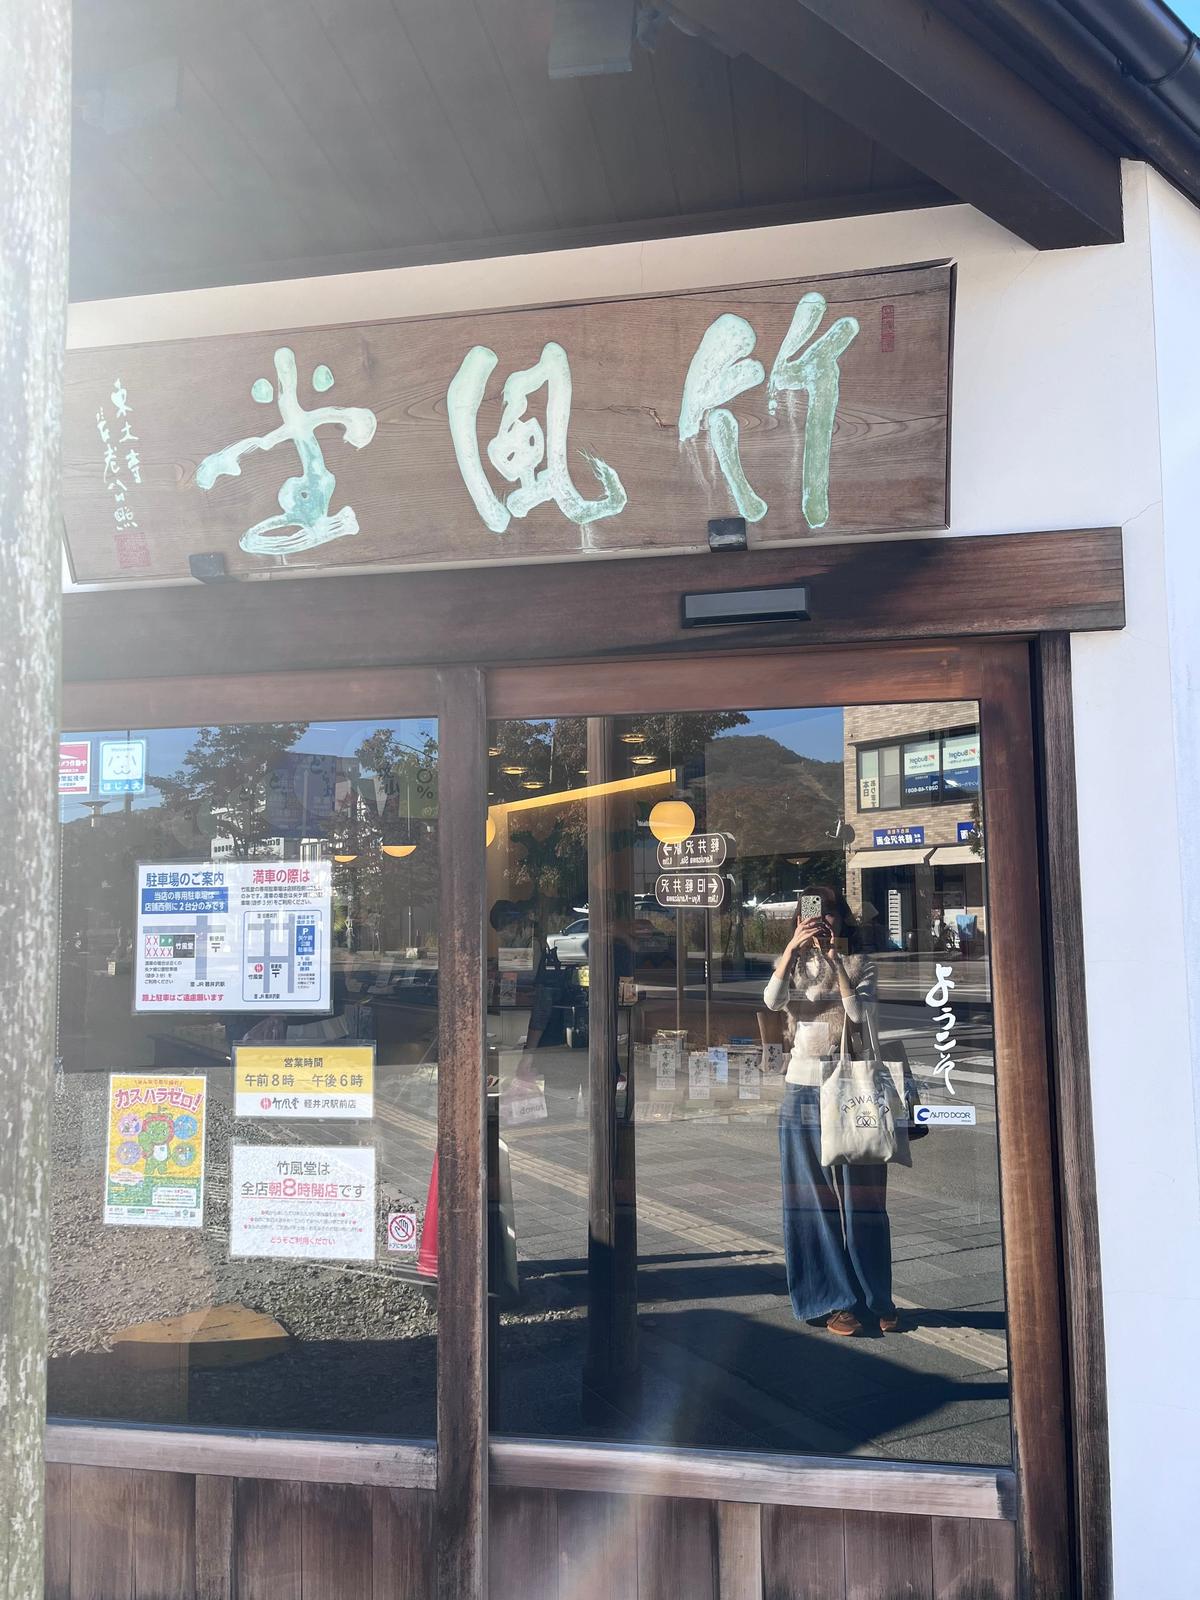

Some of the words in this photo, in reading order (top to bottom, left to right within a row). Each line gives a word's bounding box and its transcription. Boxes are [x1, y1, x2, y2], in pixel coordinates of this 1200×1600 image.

[146, 872, 224, 887] 駐車場のご案内
[252, 869, 310, 884] 満車の際は
[175, 942, 194, 950] 竹風堂
[925, 963, 957, 1095] ようこそ
[284, 1057, 323, 1068] 営業時間
[303, 1099, 357, 1109] 軽井沢駅前店
[276, 1161, 330, 1176] 竹風堂は
[241, 1178, 366, 1199] 全店朝8時開店です
